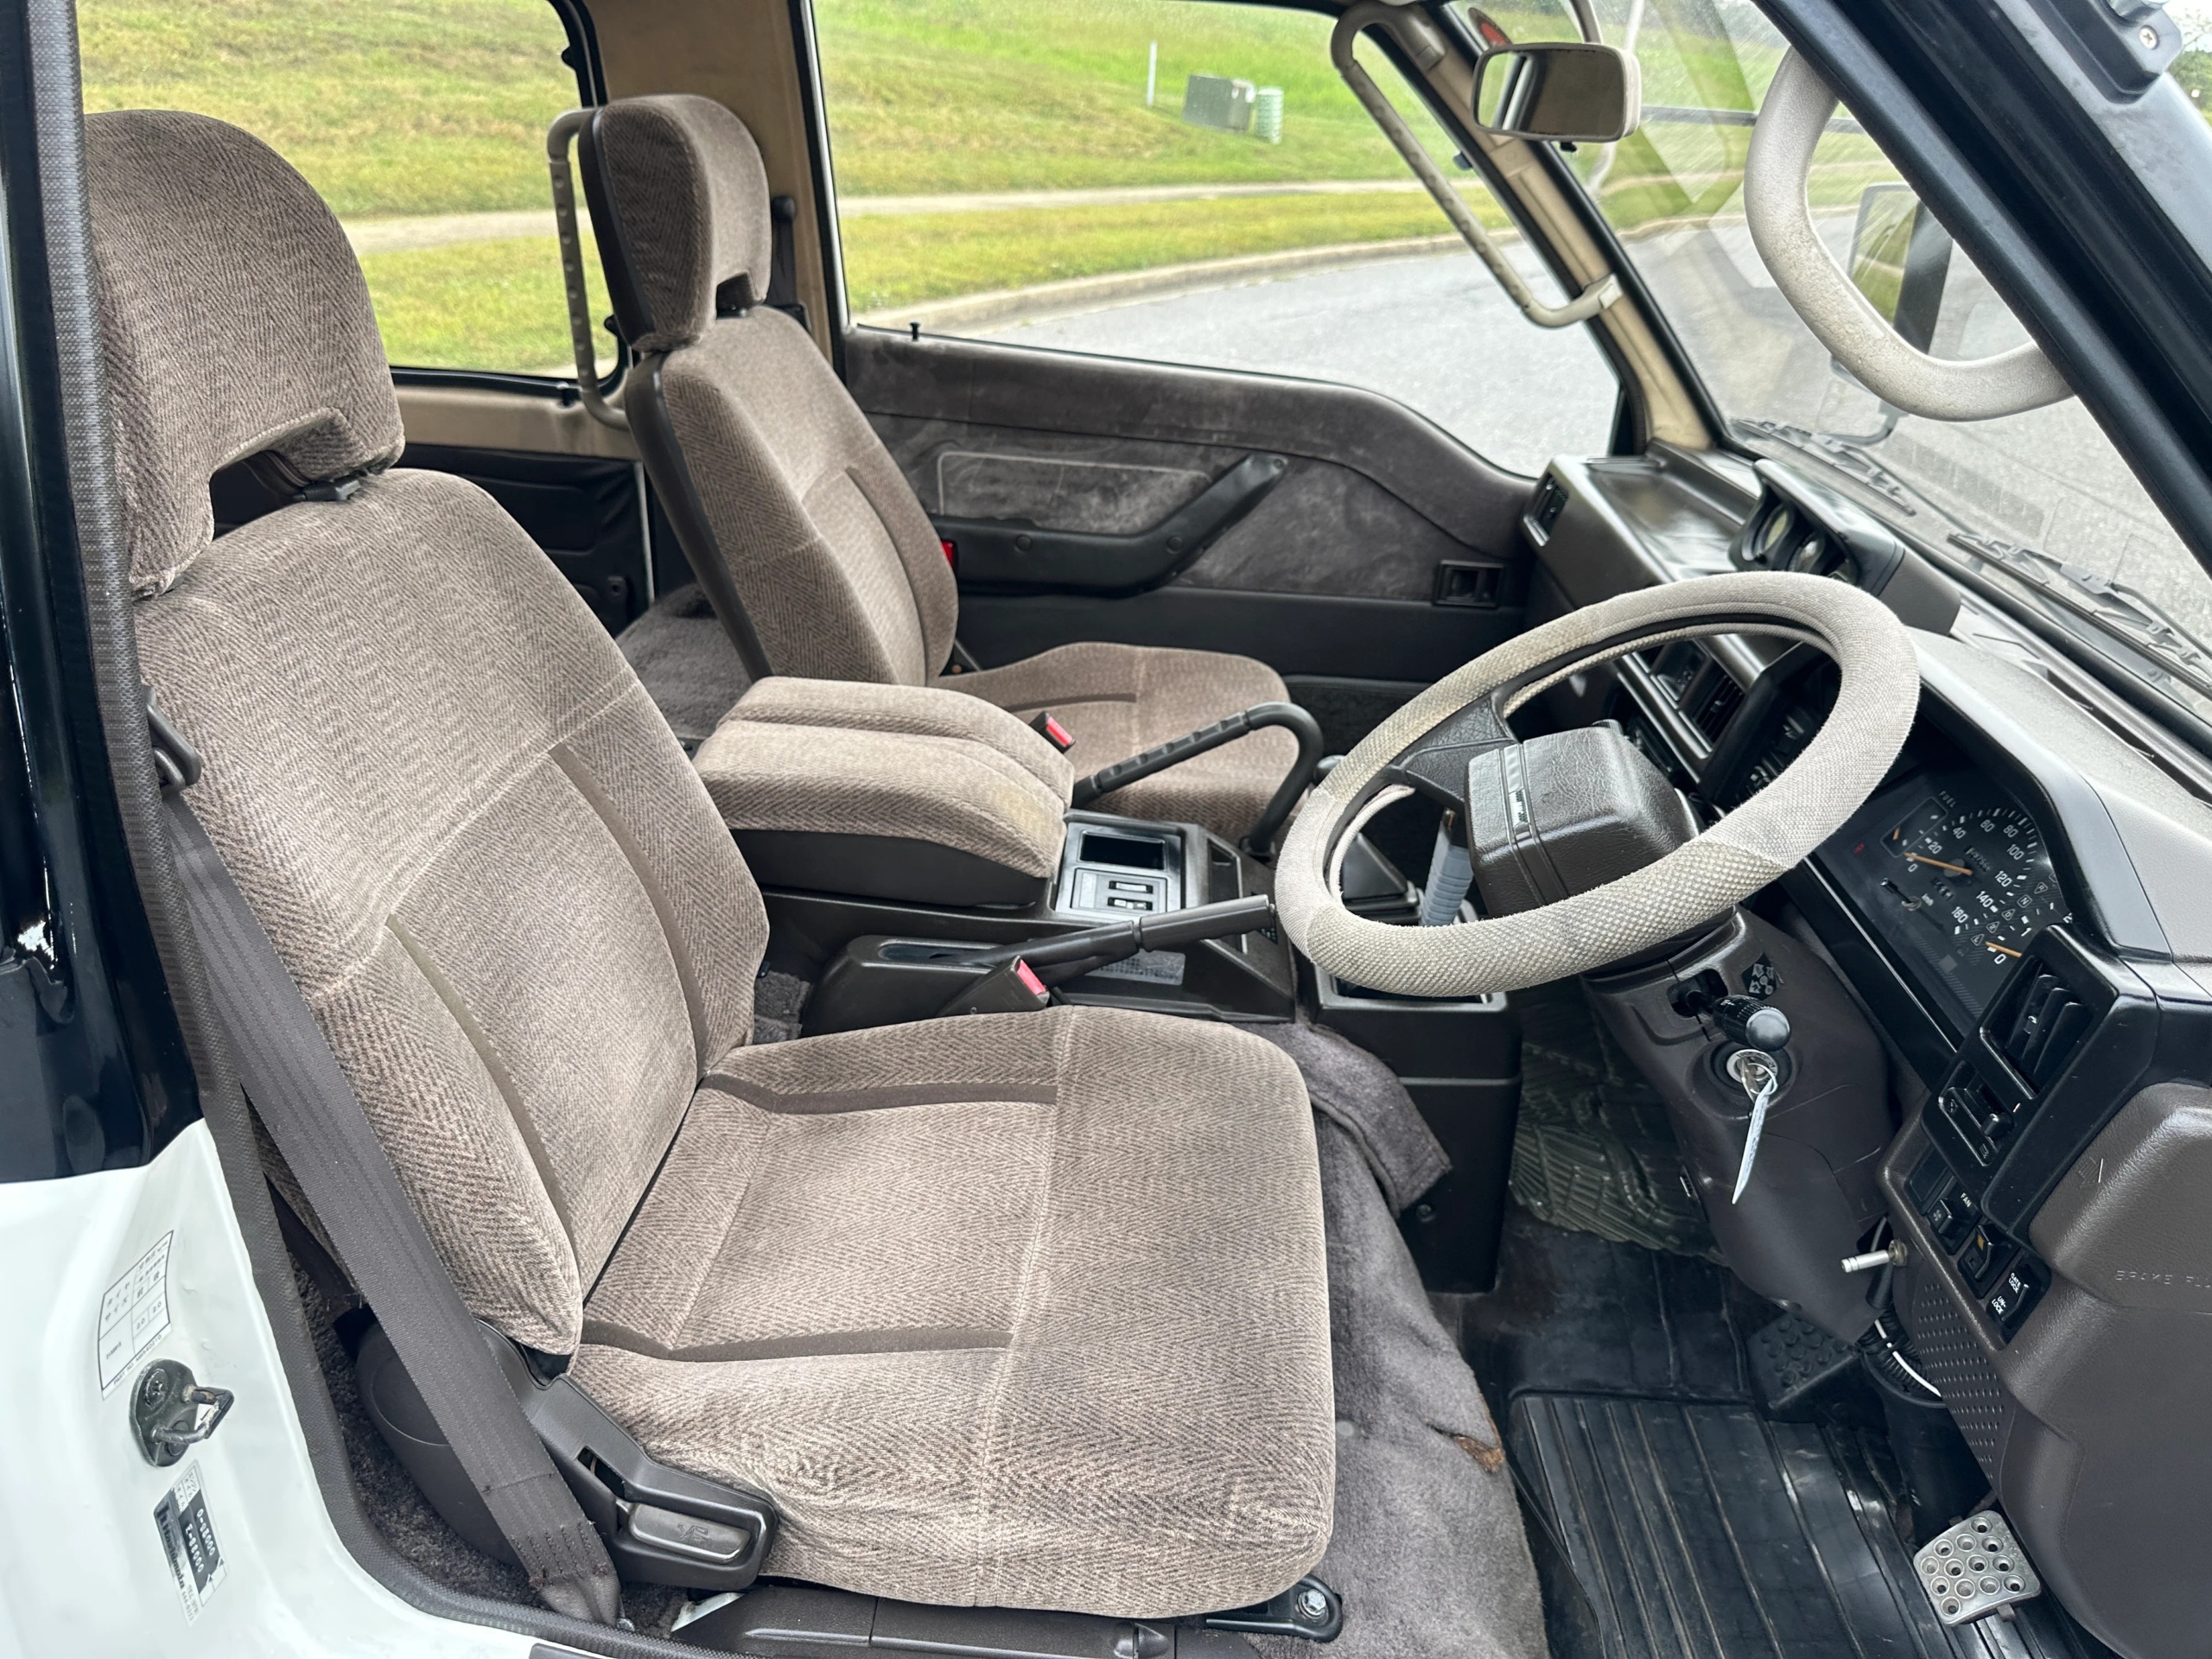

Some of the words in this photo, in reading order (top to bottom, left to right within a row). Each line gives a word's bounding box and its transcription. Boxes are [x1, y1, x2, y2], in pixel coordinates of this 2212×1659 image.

[1953, 827, 1967, 839] 40
[2003, 824, 2018, 838] 80
[1928, 841, 1942, 855] 20
[2006, 843, 2024, 861] 100
[1907, 863, 1918, 873] 0
[1994, 870, 2012, 887] 120
[1976, 890, 1994, 907] 140
[2020, 927, 2032, 938] 1
[1993, 953, 2006, 965] 0
[1961, 1192, 1972, 1208] FAN
[2008, 1278, 2019, 1294] LOCK
[2011, 1272, 2022, 1288] GATE
[1991, 1298, 2004, 1315] LOCK
[1997, 1295, 2006, 1308] UN-
